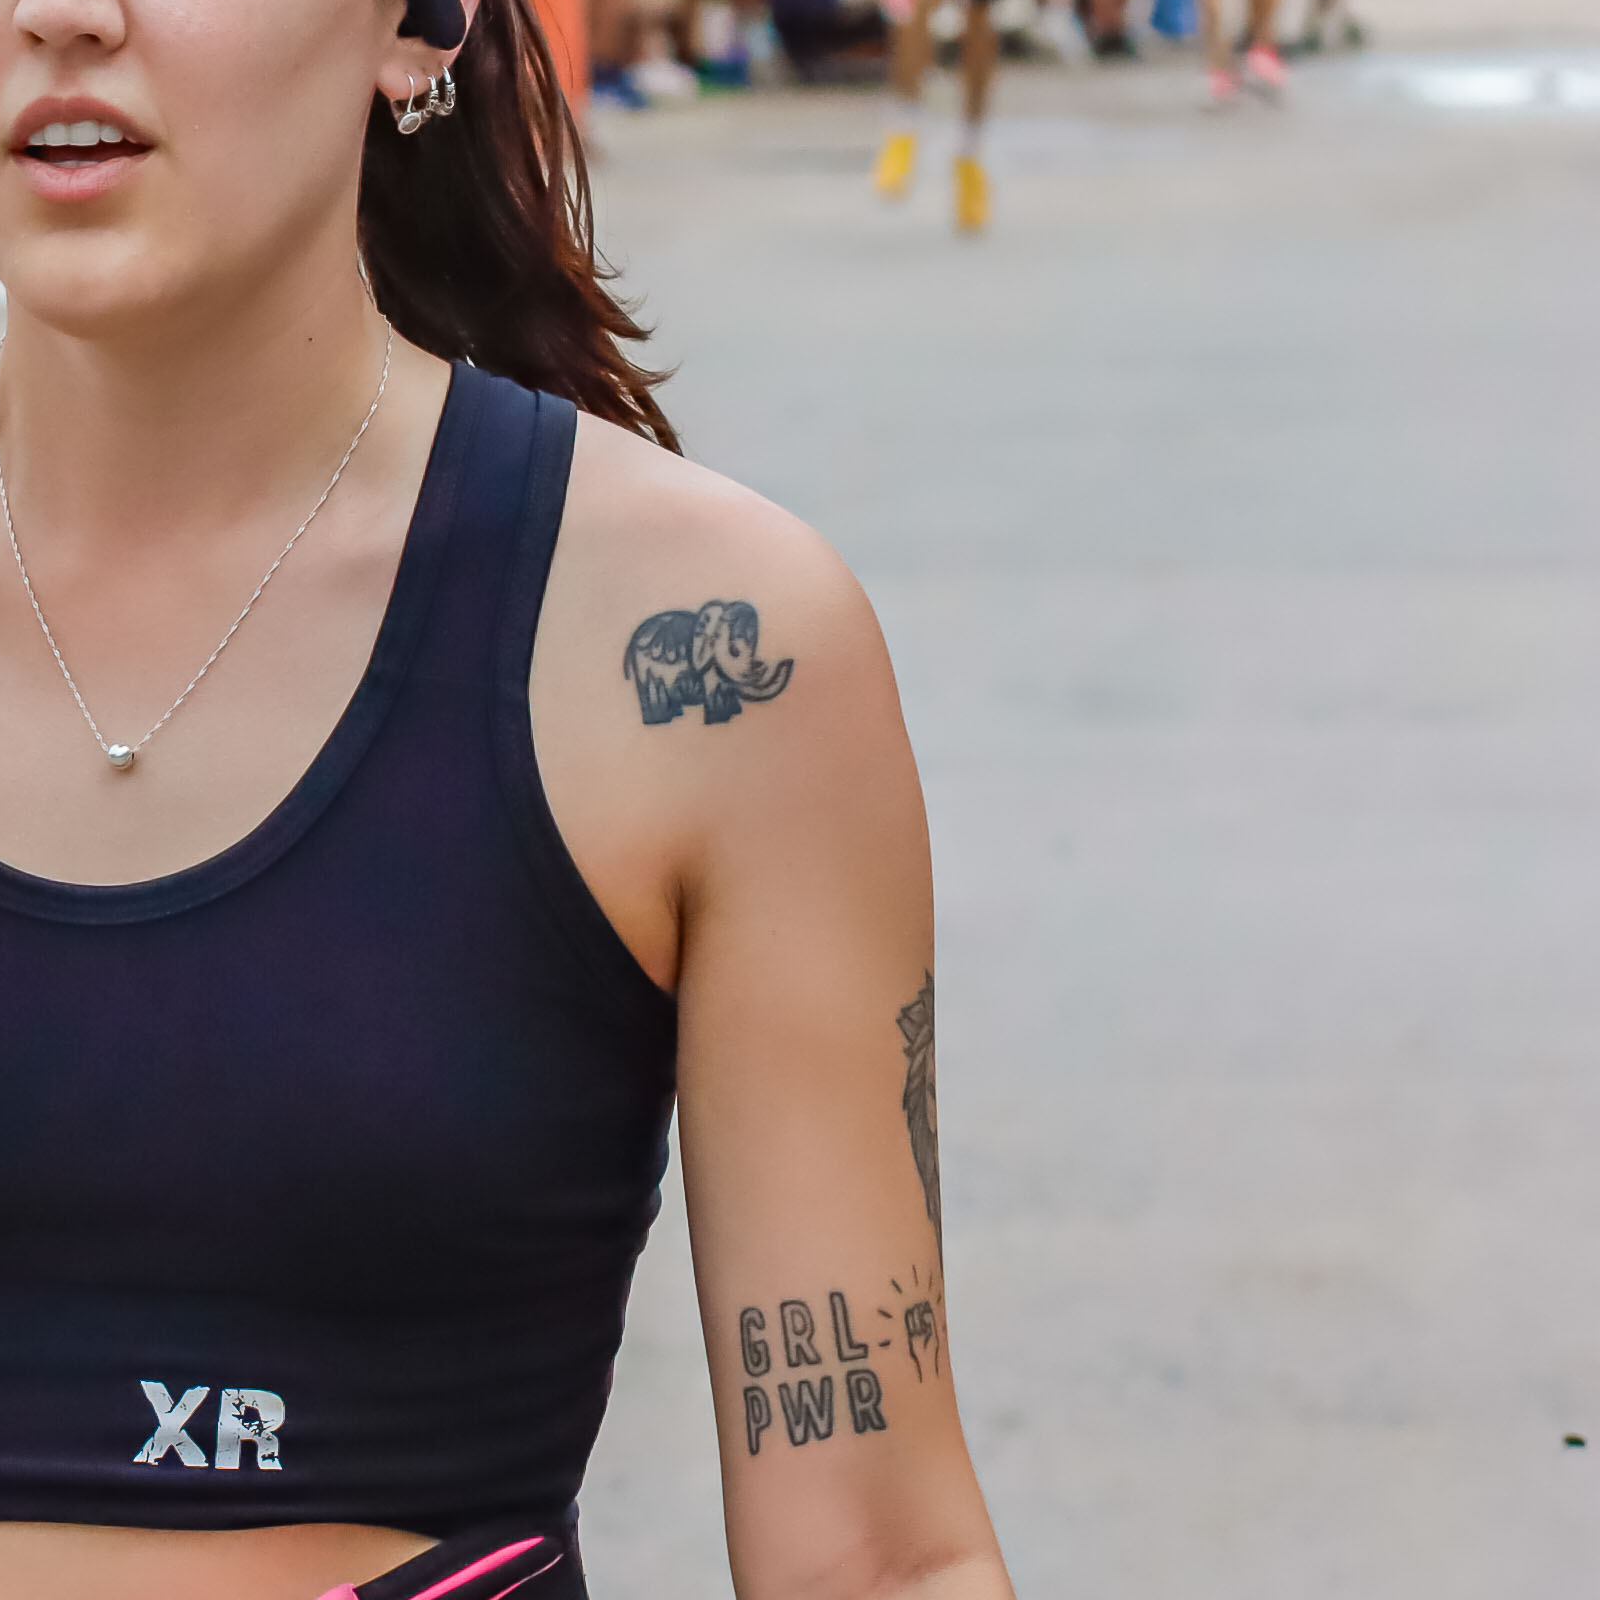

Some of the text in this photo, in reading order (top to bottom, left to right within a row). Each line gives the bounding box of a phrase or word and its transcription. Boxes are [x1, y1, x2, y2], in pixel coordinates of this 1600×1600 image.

[740, 1291, 869, 1377] GRL
[133, 1379, 286, 1470] XR
[743, 1368, 887, 1456] PWR
